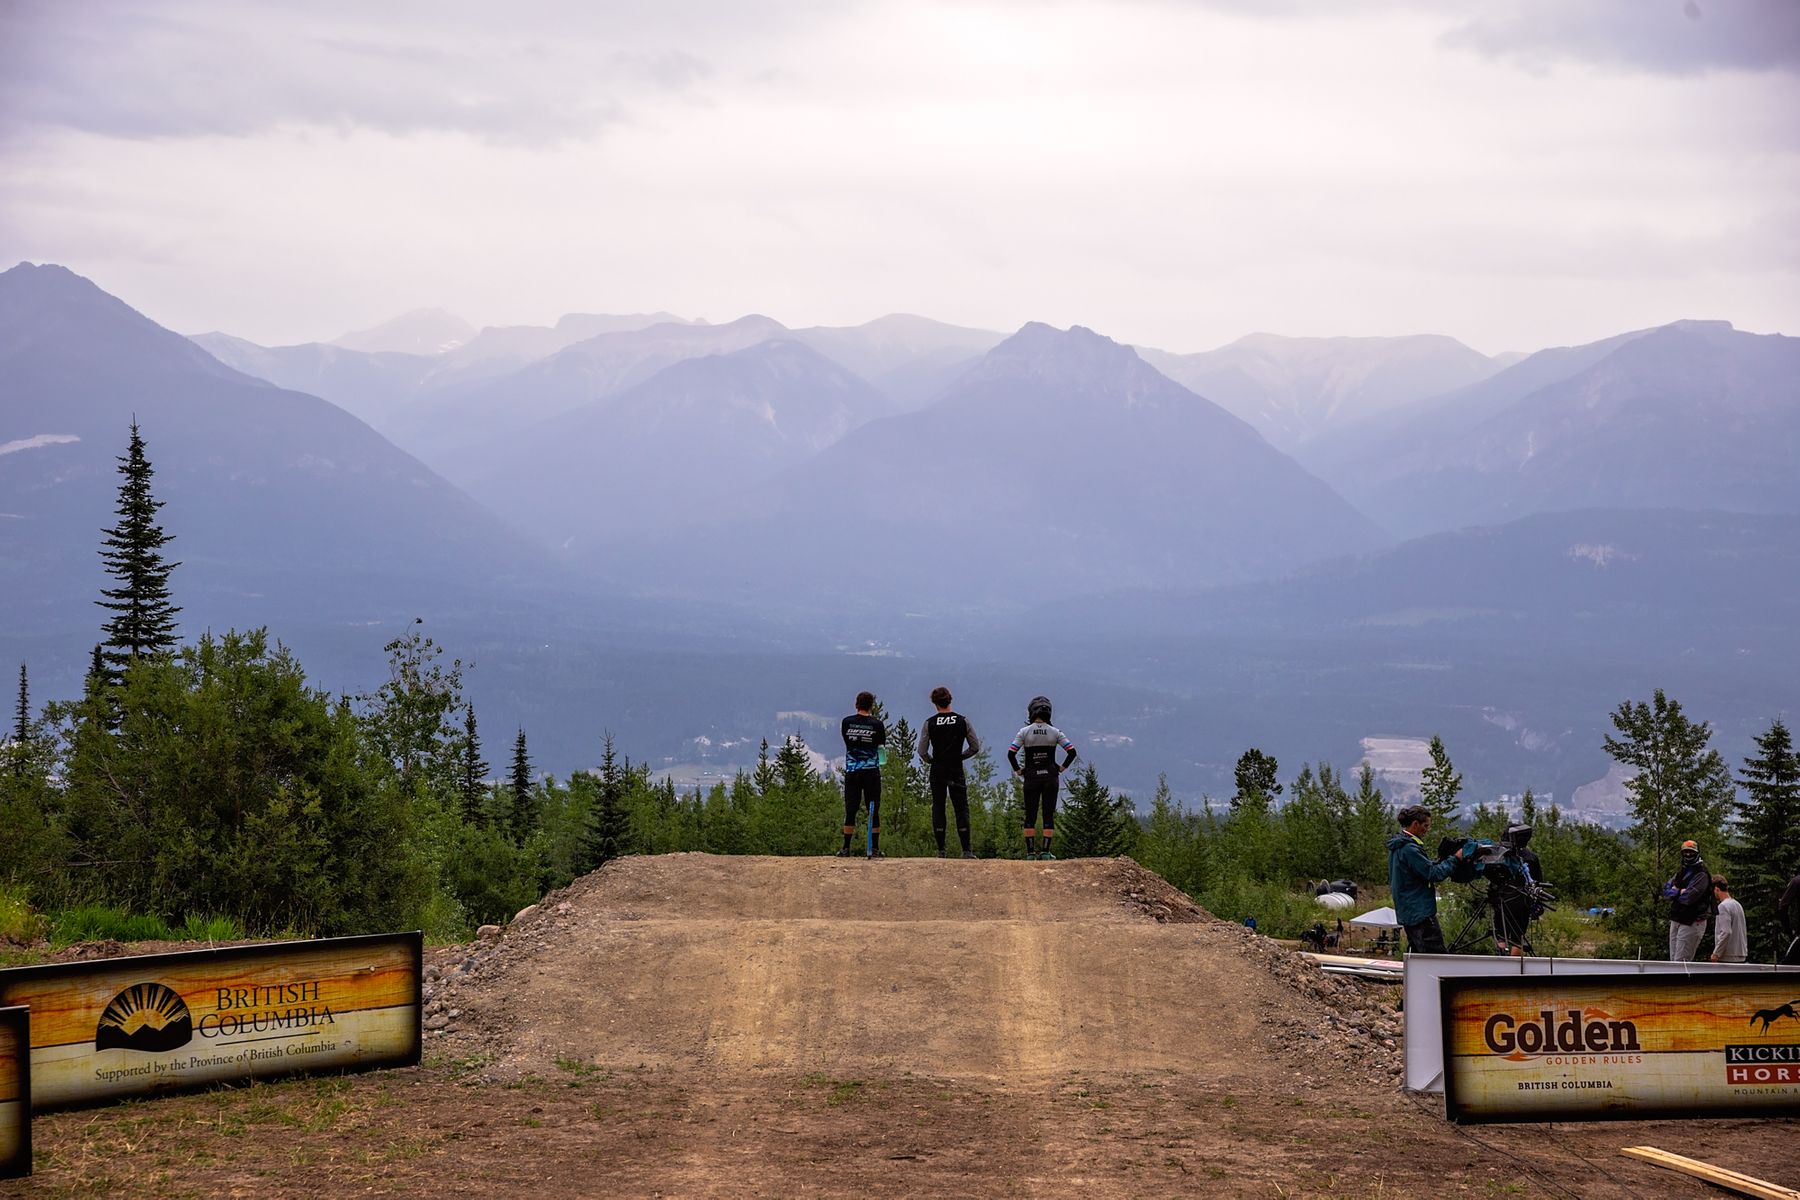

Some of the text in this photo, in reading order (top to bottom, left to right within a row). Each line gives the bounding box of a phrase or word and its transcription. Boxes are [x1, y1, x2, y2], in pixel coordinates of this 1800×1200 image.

[936, 715, 957, 726] BAS
[215, 981, 320, 1011] BRITISH
[199, 1005, 335, 1039] COLUMBIA
[1484, 1010, 1641, 1053] Golden
[1546, 1055, 1642, 1065] GOLDEN RULES
[1730, 1046, 1800, 1061] KICKI
[95, 1042, 336, 1083] Supported by the Province of British Columbia
[1732, 1067, 1800, 1081] HOR
[1518, 1080, 1613, 1090] BRITISH COLUMBIA
